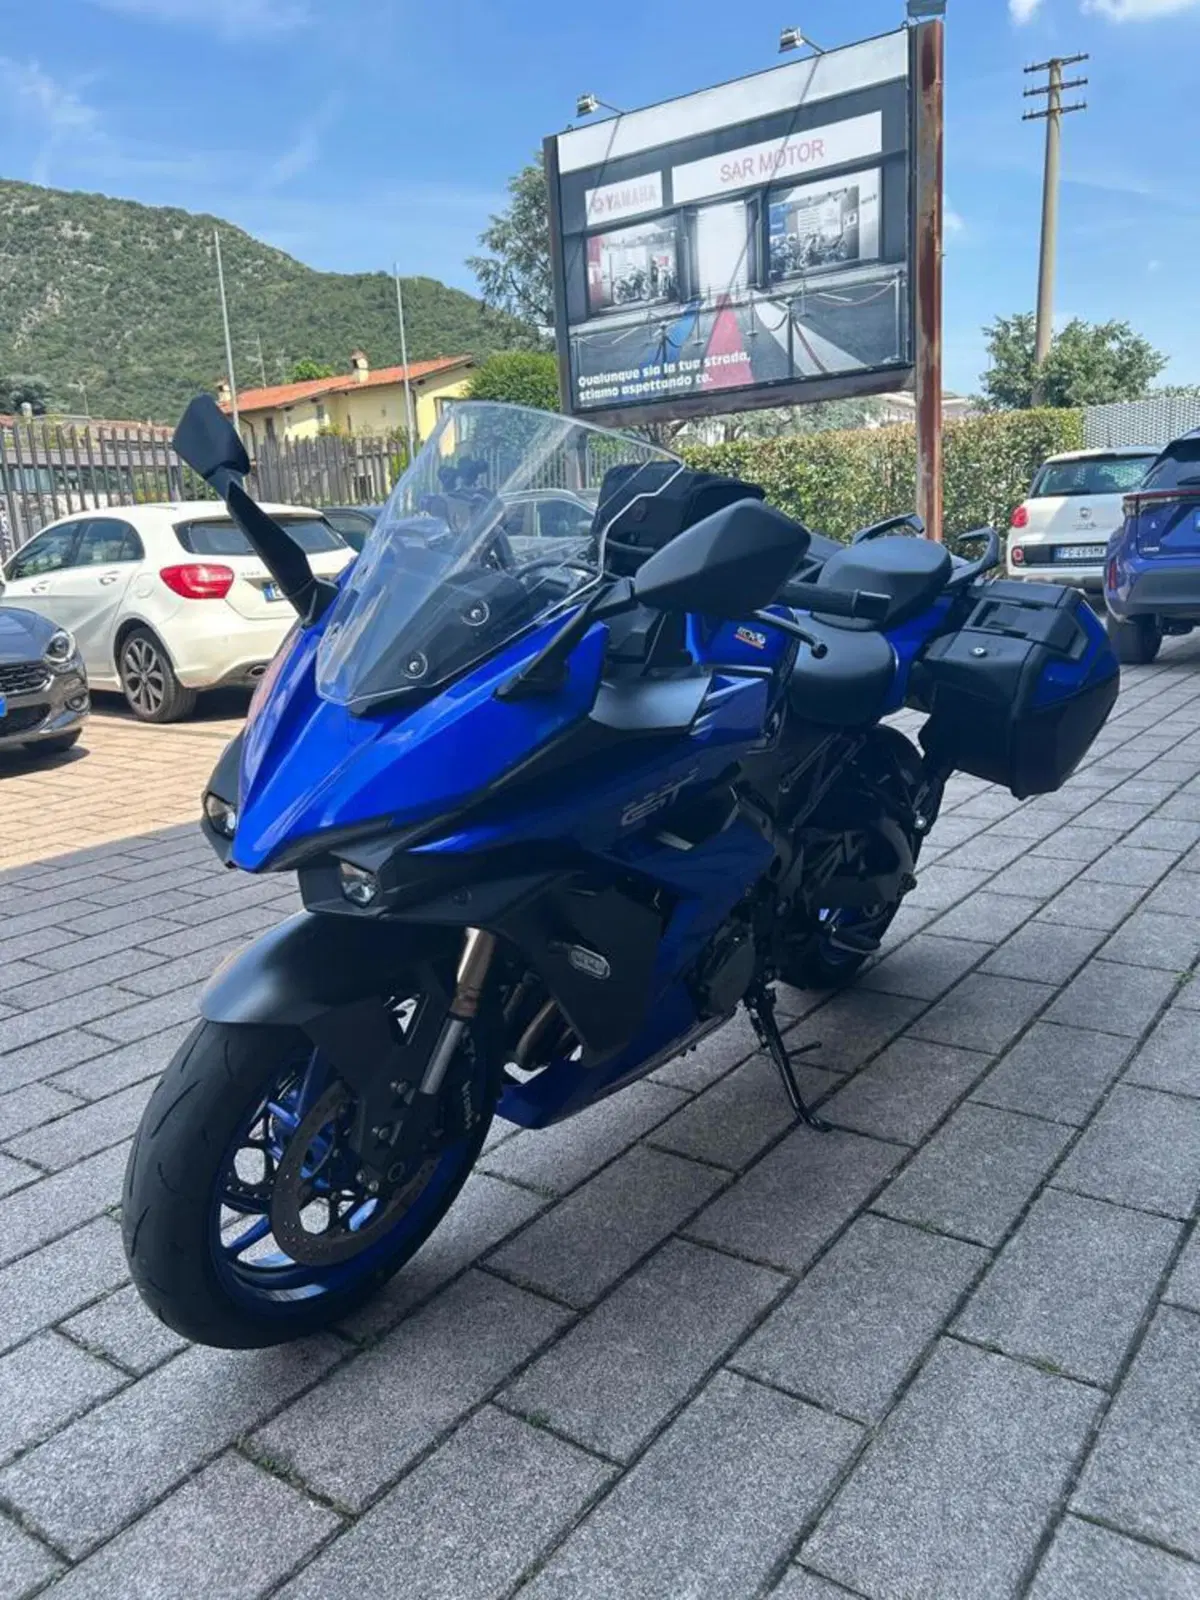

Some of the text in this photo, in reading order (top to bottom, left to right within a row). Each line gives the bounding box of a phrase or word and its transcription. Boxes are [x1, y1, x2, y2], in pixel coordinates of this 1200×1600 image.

[720, 139, 824, 183] SAR MOTOR
[607, 184, 657, 210] YAMAHA
[578, 372, 640, 388] Qualunque
[643, 364, 661, 376] sia
[664, 362, 675, 374] la
[679, 359, 700, 371] tua
[578, 388, 619, 401] stiamo
[622, 378, 692, 395] aspettando
